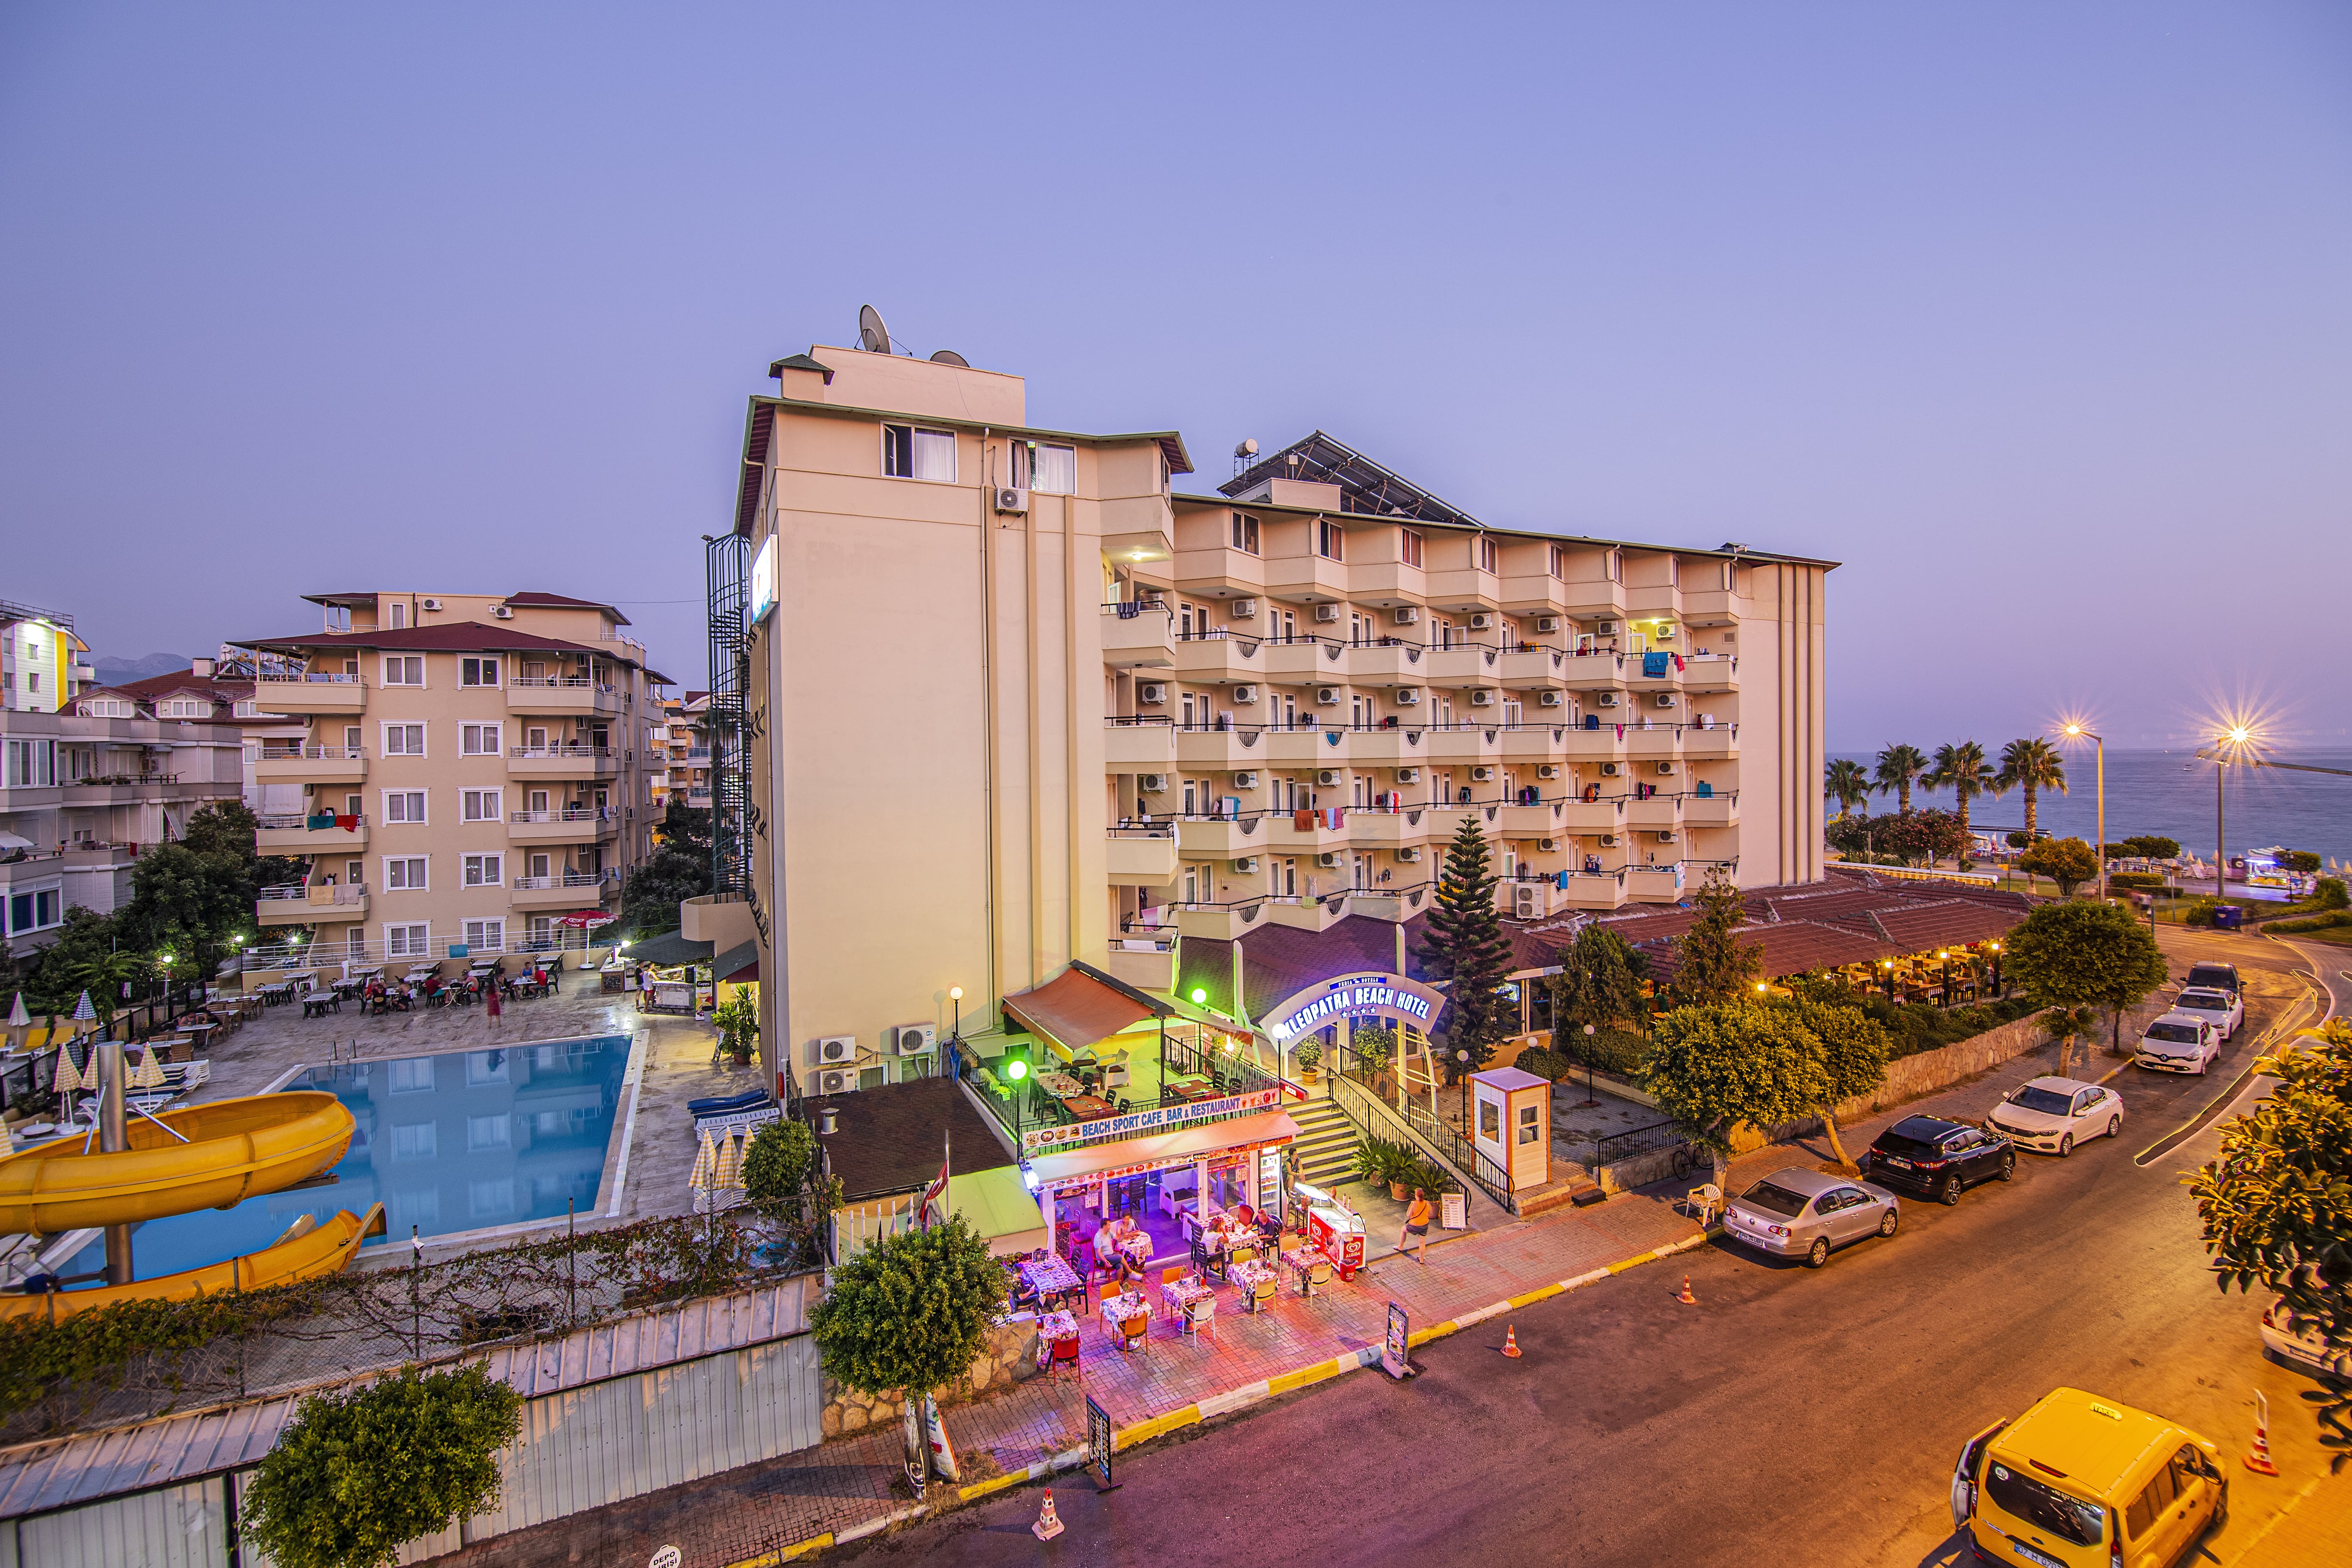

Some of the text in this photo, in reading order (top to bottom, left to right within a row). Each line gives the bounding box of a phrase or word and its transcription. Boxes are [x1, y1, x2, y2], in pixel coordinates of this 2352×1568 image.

[1284, 987, 1431, 1040] KLEOPATRA BEACH HOTEL
[1285, 1085, 1297, 1096] pizza
[1082, 1097, 1240, 1137] BEACH SPORT CAFE BAR & RESTAURANT
[1311, 1233, 1321, 1243] ALGIDA
[654, 1551, 675, 1566] DEPO
[2018, 1546, 2027, 1555] 07
[2032, 1553, 2038, 1561] H
[656, 1557, 677, 1568] İRİŞİ
